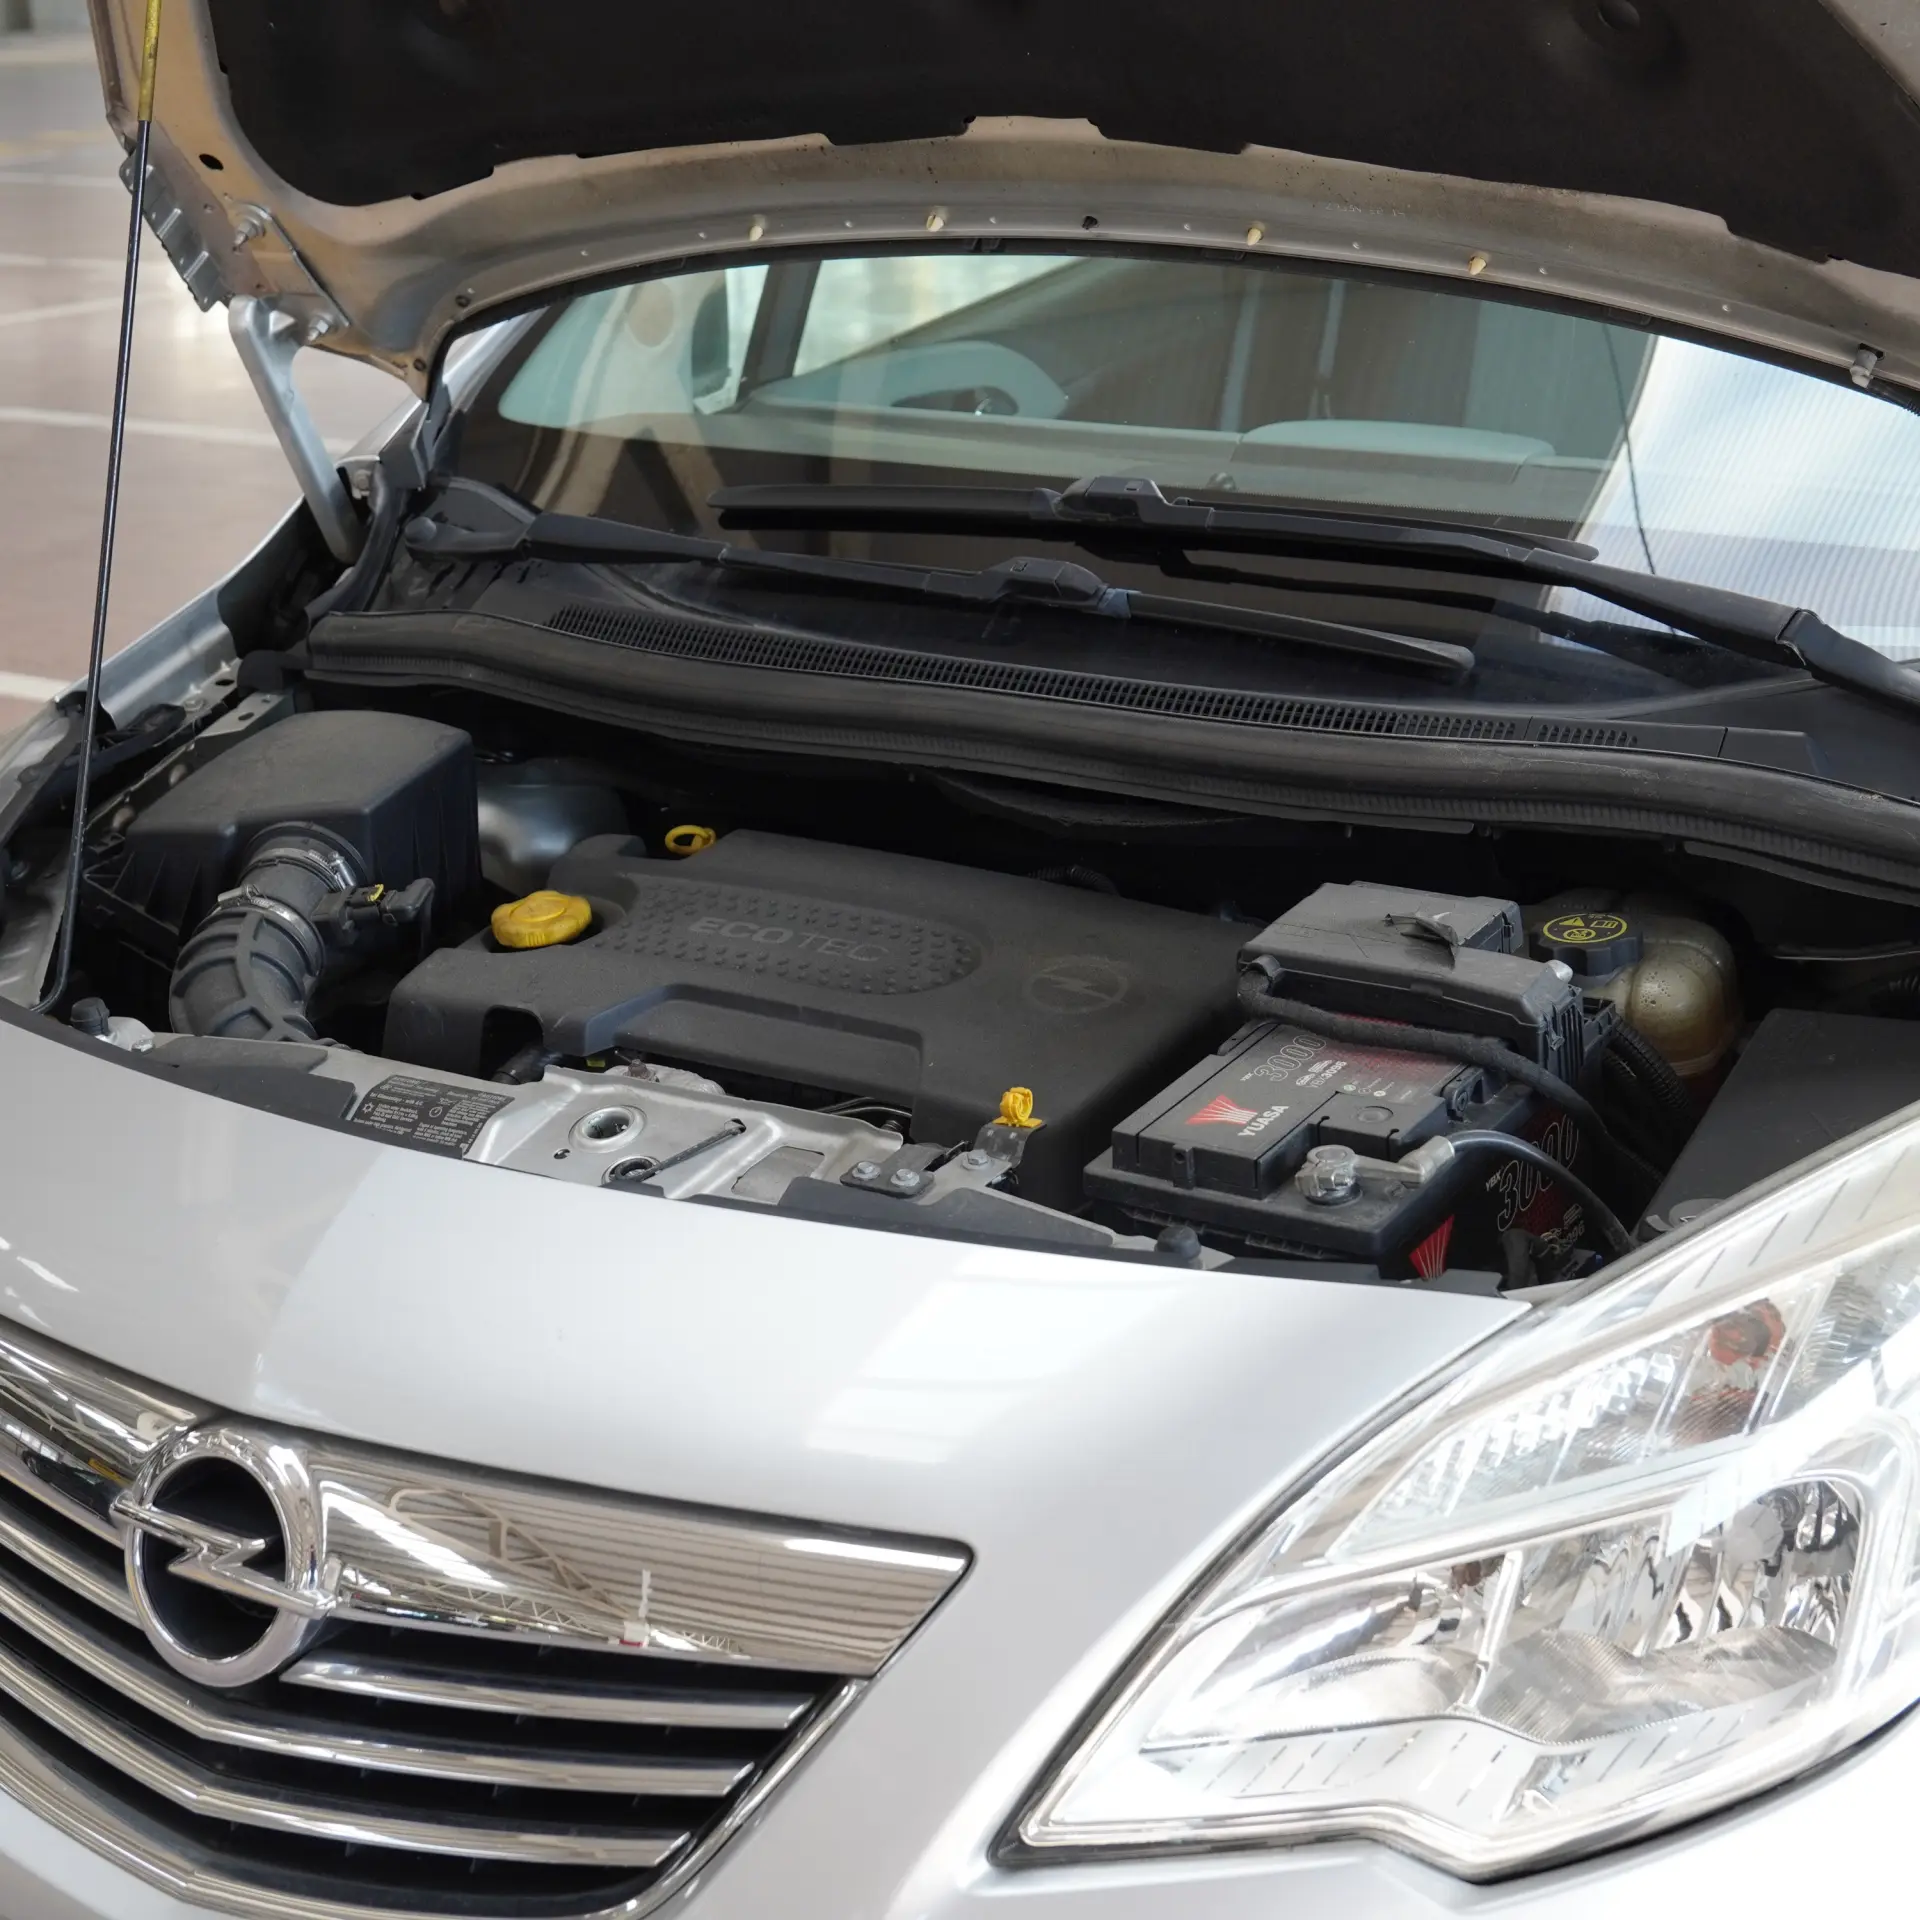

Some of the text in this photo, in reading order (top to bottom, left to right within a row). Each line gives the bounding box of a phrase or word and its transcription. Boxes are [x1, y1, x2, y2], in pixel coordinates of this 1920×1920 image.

[688, 916, 889, 962] ECOTEC
[1253, 1035, 1327, 1082] 3000
[1237, 1105, 1290, 1137] YUASA
[1485, 1168, 1502, 1192] YBX
